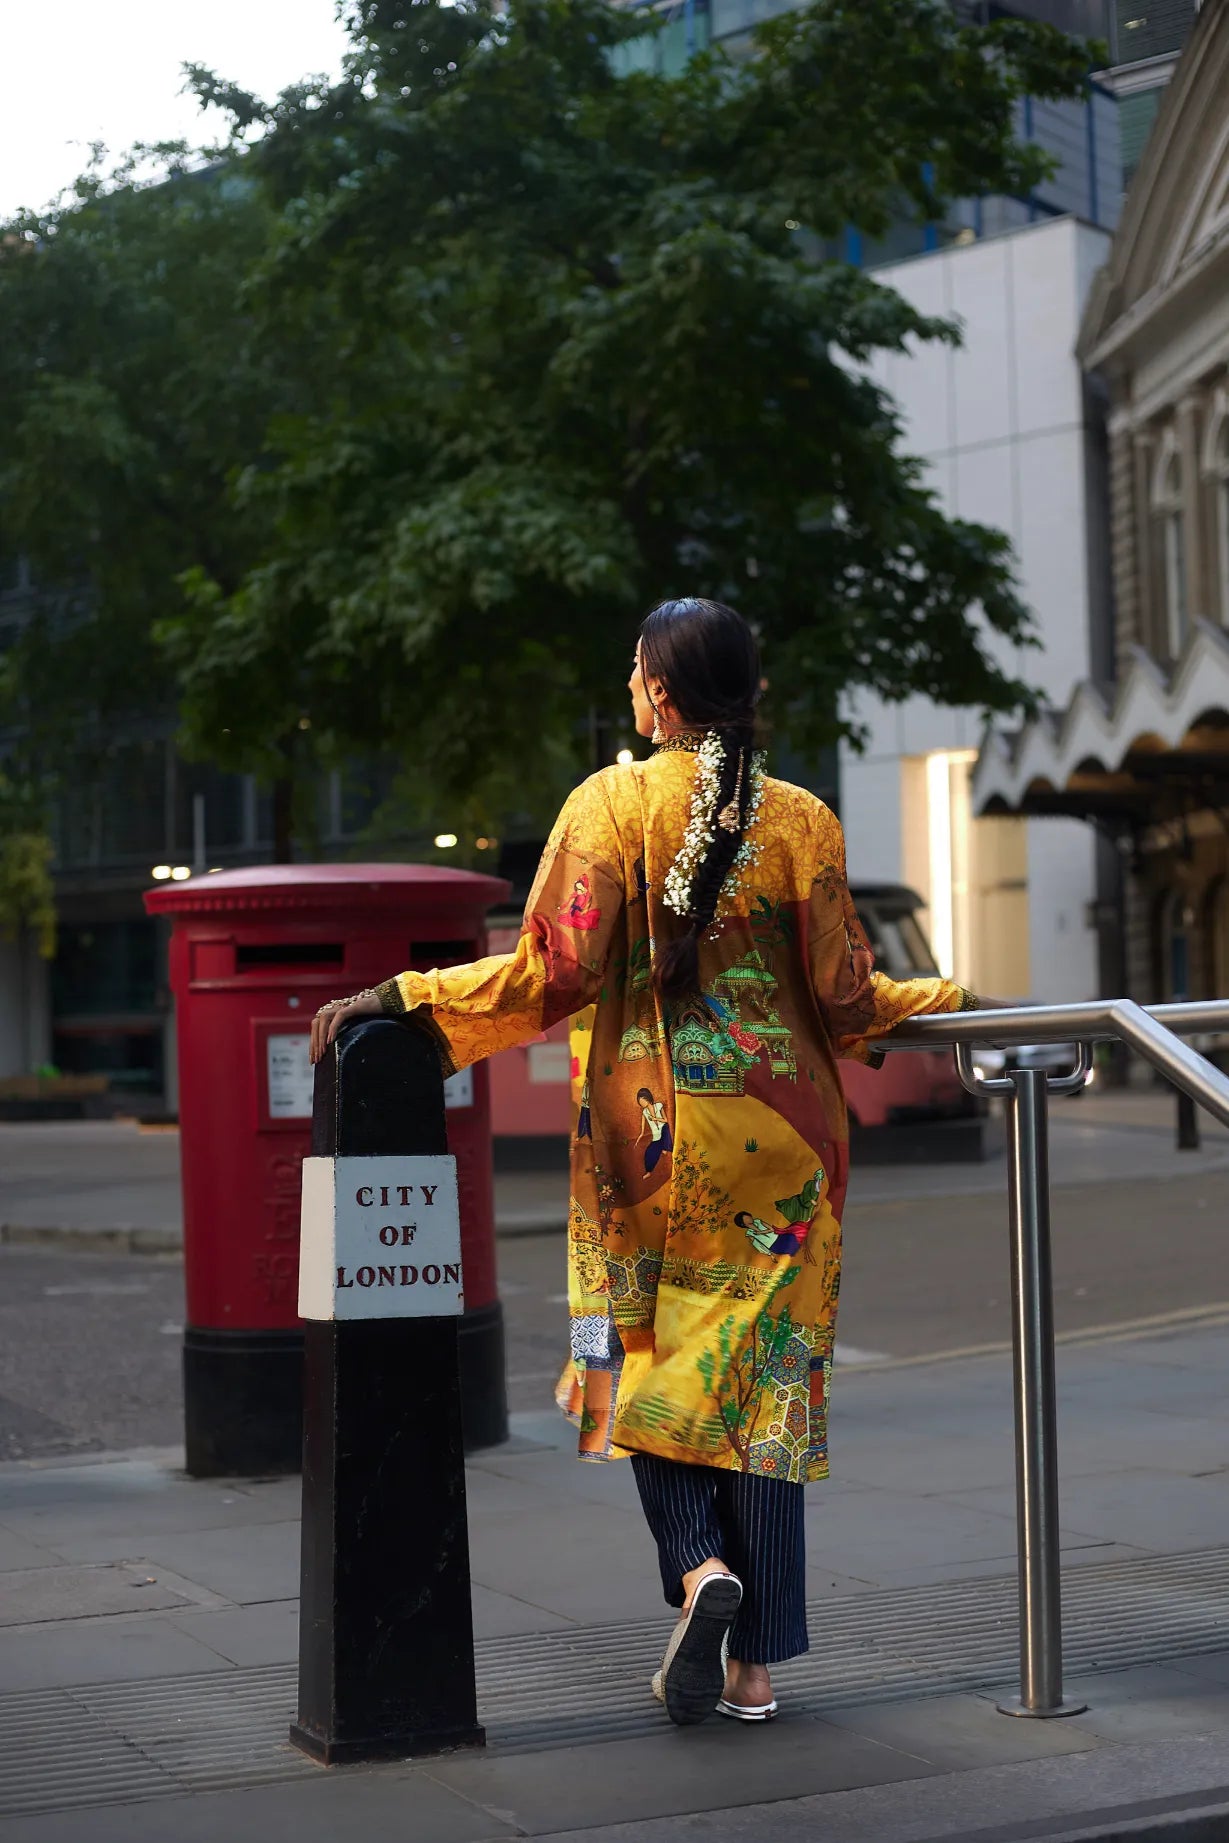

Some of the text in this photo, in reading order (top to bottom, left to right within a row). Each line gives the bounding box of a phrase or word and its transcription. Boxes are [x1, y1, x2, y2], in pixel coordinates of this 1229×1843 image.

[356, 1186, 438, 1207] CITY
[379, 1226, 418, 1247] OF
[337, 1264, 461, 1289] LONDON
